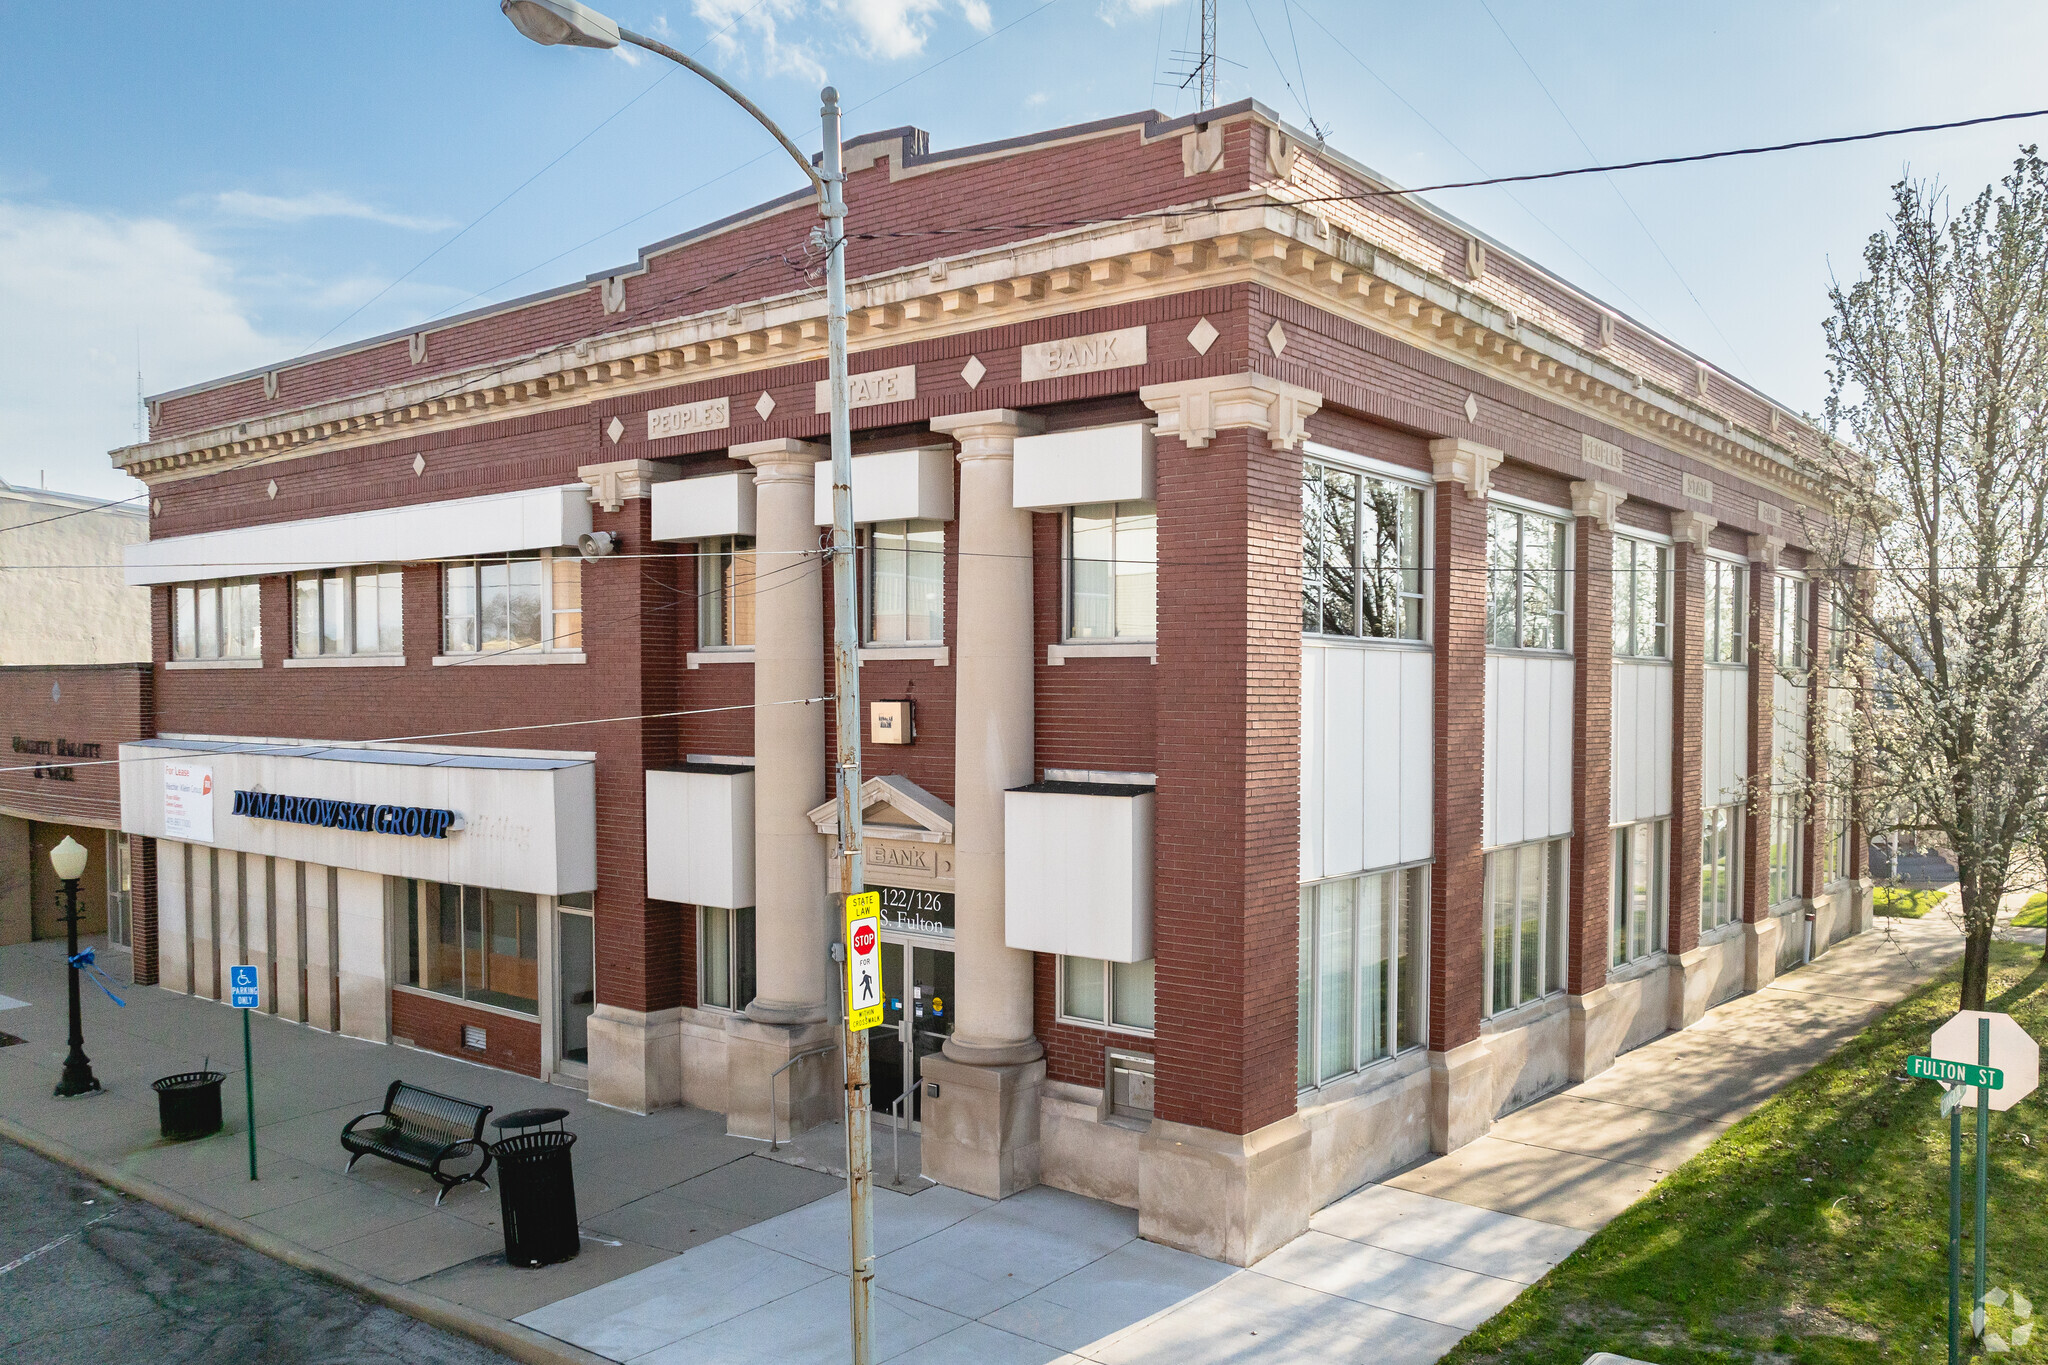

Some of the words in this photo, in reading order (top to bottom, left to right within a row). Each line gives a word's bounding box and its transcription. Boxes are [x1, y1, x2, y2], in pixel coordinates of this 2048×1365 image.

[652, 404, 725, 434] PEOPLES
[847, 373, 898, 403] TATE
[1047, 337, 1118, 372] BANK
[1584, 439, 1622, 468] PEOPLES
[175, 767, 190, 777] Lease
[232, 789, 376, 832] DYMARKOWSKI
[373, 804, 452, 839] GROUP
[874, 847, 926, 868] BANK
[853, 895, 874, 907] STATE
[882, 888, 942, 912] 122/126
[856, 907, 871, 917] LAW
[880, 909, 892, 927] S.
[897, 911, 943, 933] Fulton
[854, 933, 874, 948] STOP
[860, 958, 871, 967] FOR
[231, 986, 258, 995] PARKING
[237, 996, 253, 1005] ONLY
[858, 1008, 875, 1018] WITHIN
[853, 1015, 881, 1028] CROSSWALK
[1915, 1058, 1966, 1081] FULTON
[1978, 1069, 1996, 1086] ST
